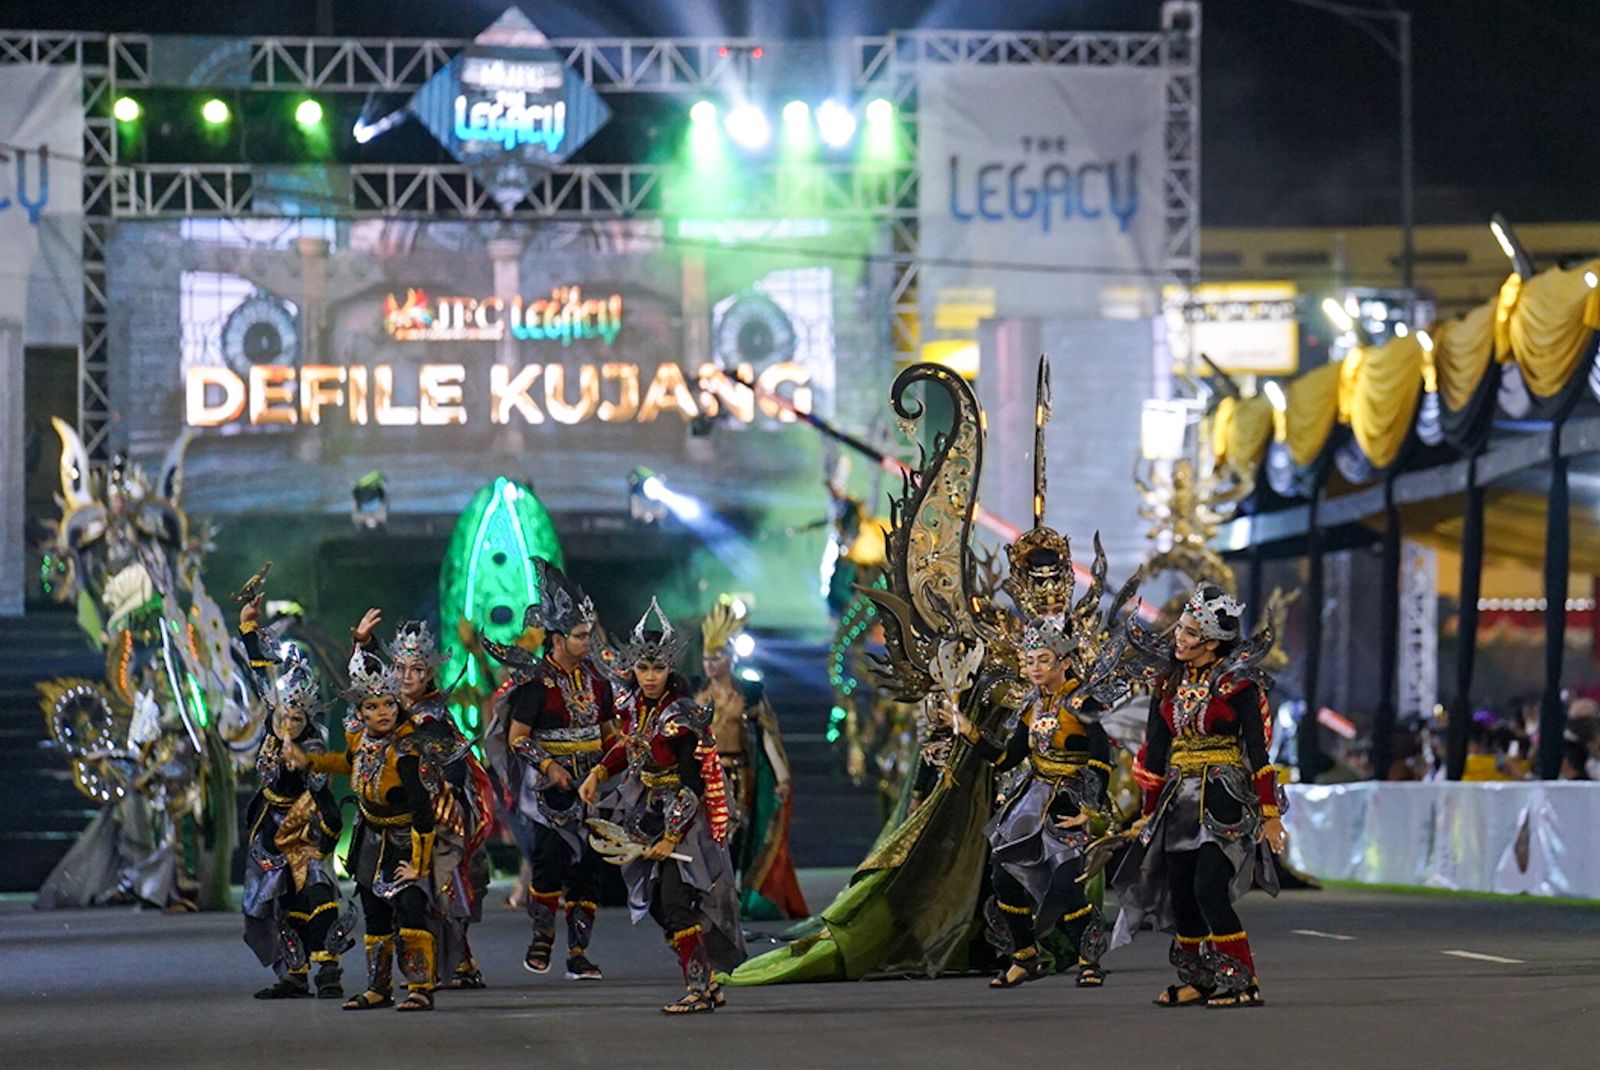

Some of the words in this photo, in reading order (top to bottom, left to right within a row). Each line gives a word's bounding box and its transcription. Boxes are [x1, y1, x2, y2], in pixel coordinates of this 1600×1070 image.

[455, 95, 565, 152] LEGACY
[1022, 137, 1067, 153] THE
[951, 153, 1139, 233] LEGACY
[432, 295, 505, 329] JFC
[510, 293, 623, 347] LEGACY
[185, 363, 468, 427] DEFILE
[490, 361, 814, 425] KUJANG
